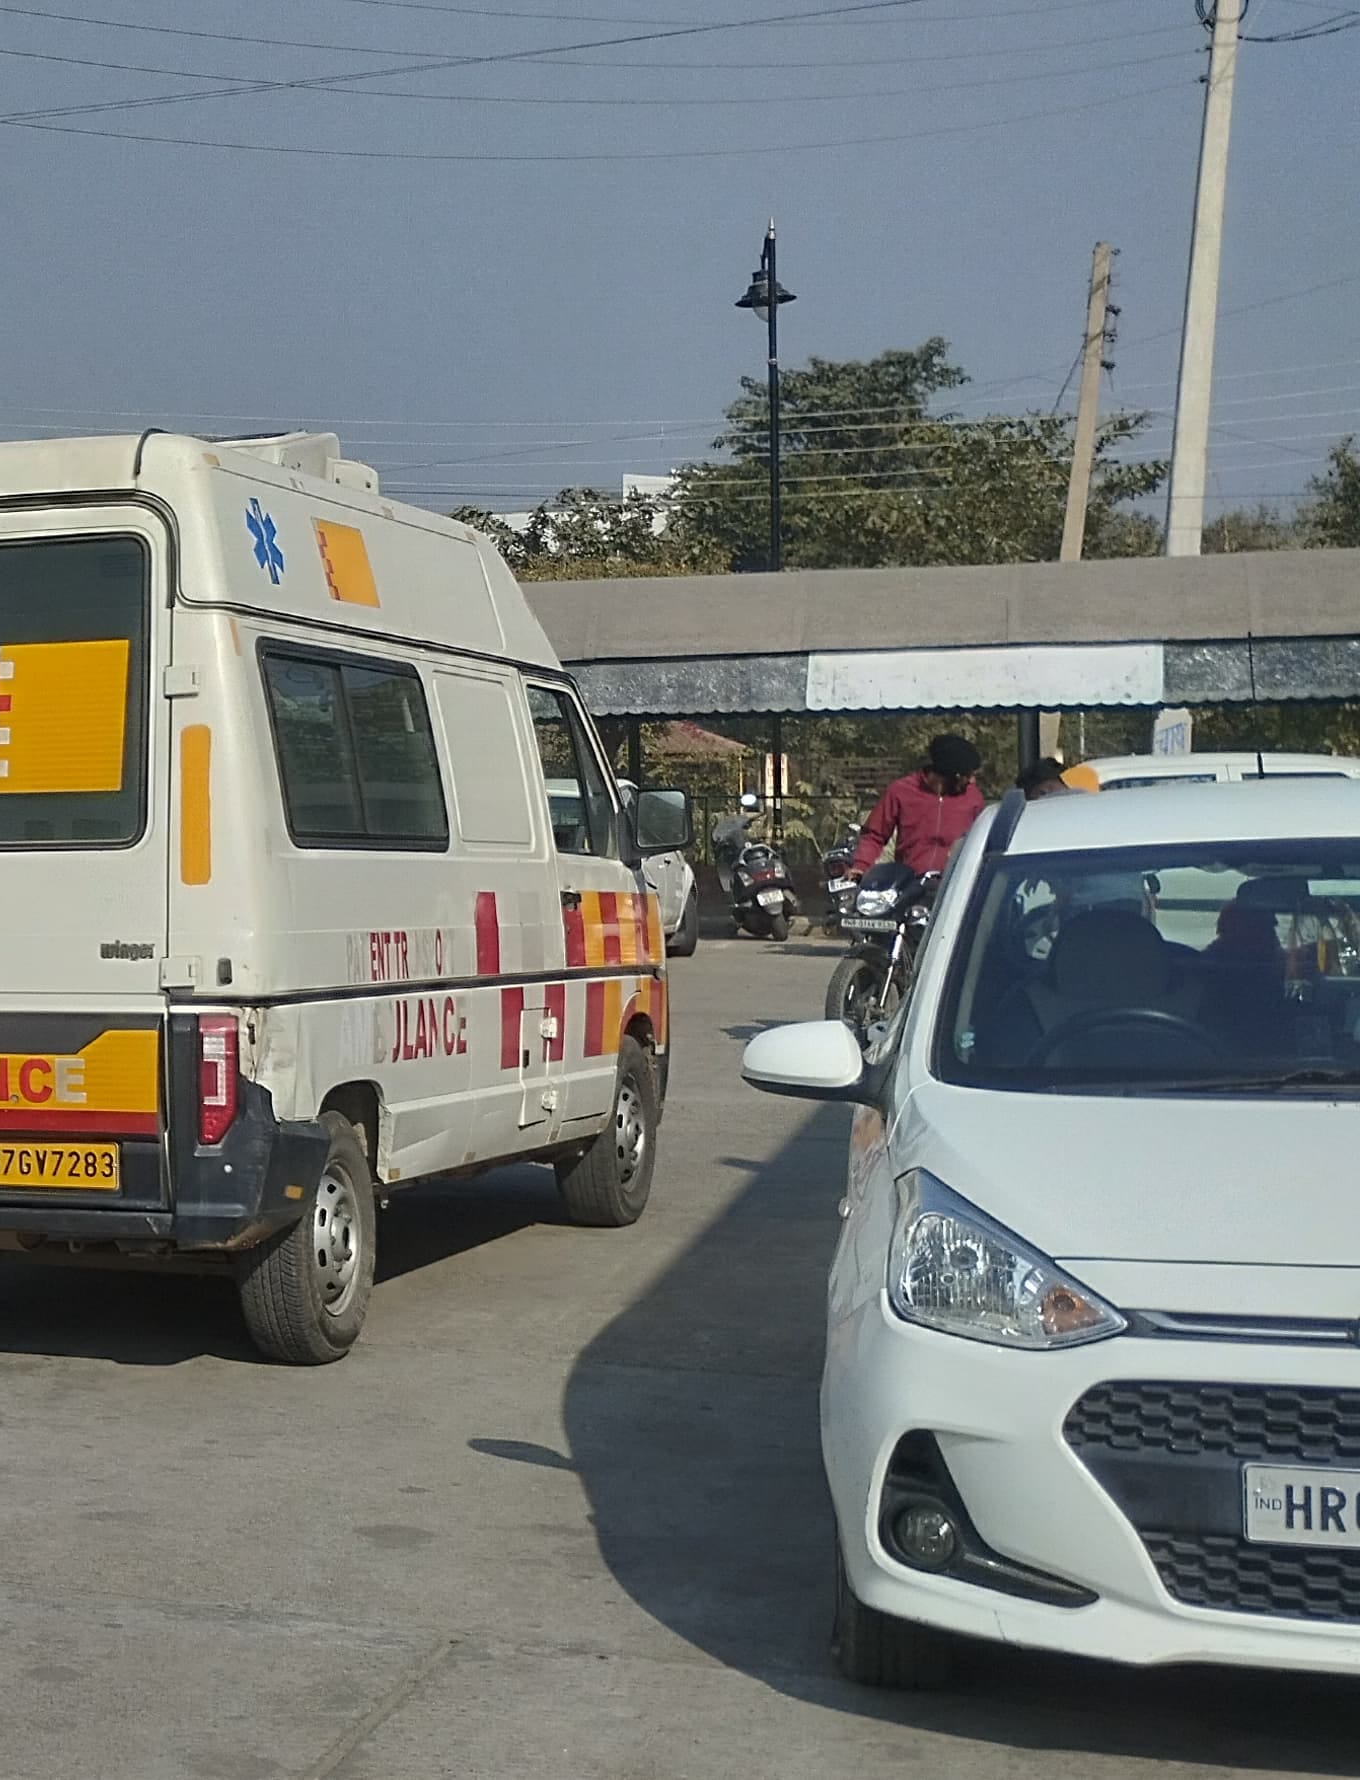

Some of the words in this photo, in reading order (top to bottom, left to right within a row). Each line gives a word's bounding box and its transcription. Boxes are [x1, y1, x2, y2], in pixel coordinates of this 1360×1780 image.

[99, 940, 155, 961] winger
[346, 931, 390, 984] PATENT
[1254, 1497, 1282, 1511] IND
[1284, 1484, 1360, 1532] HR
